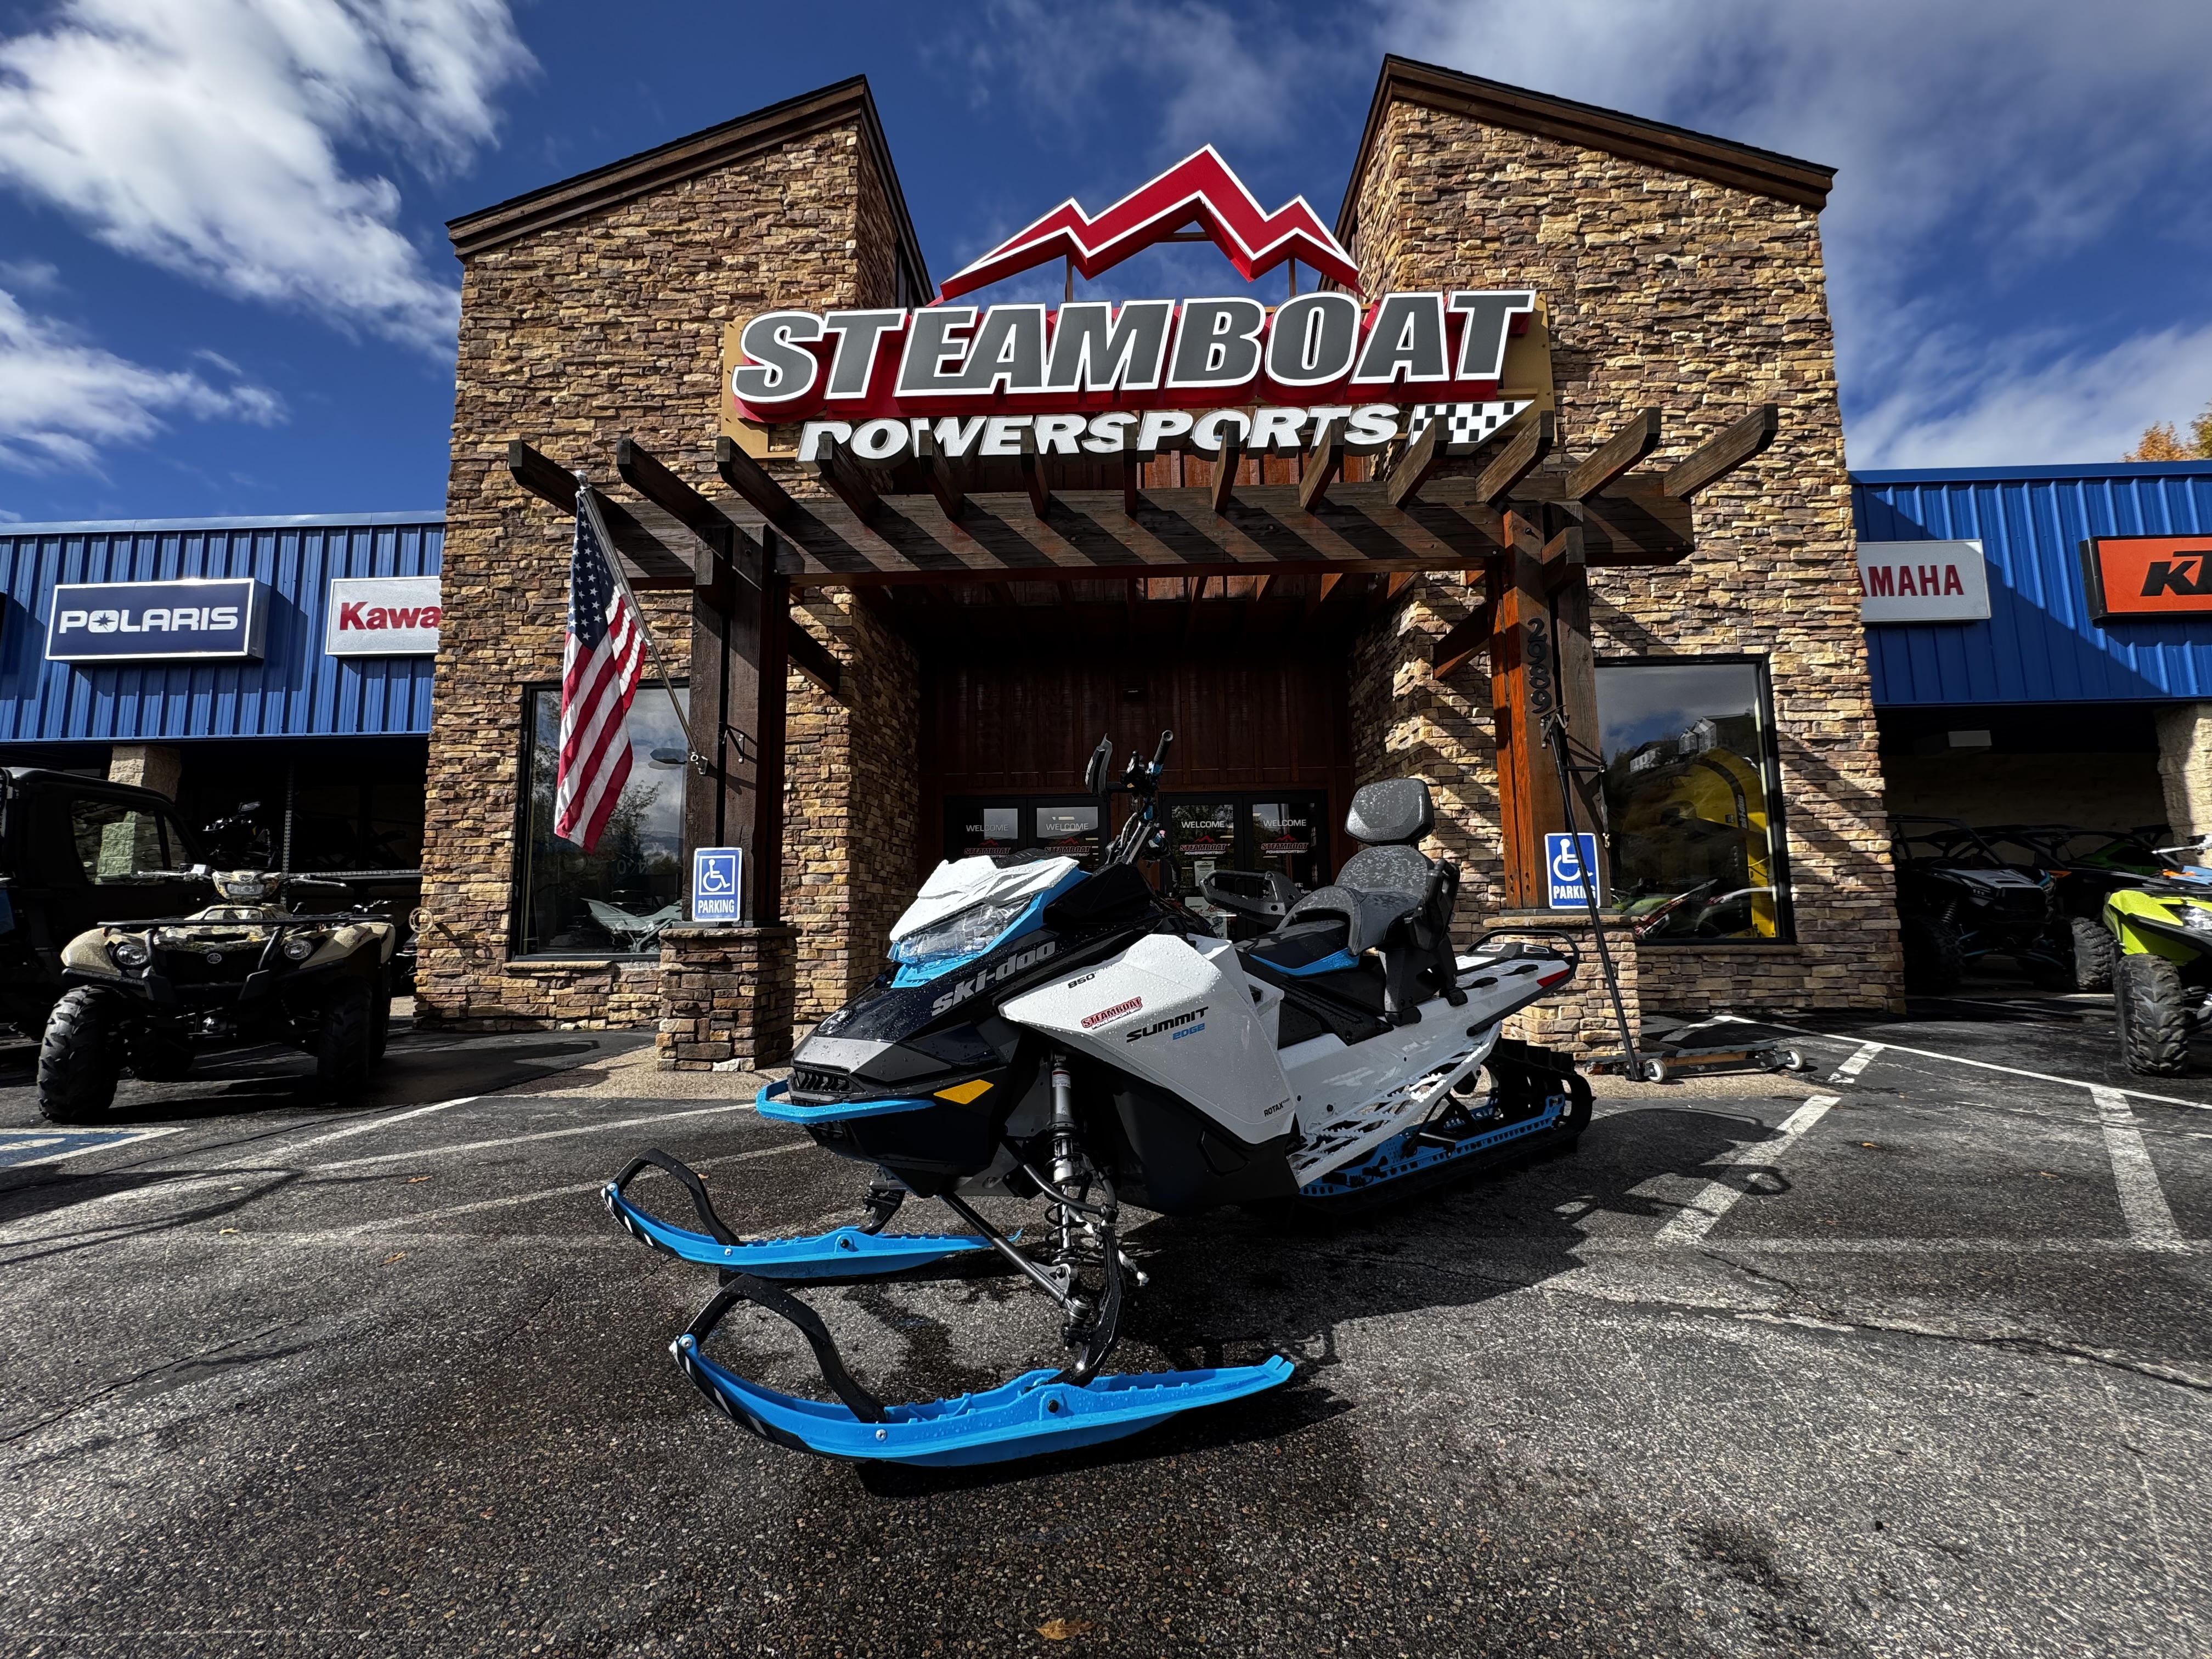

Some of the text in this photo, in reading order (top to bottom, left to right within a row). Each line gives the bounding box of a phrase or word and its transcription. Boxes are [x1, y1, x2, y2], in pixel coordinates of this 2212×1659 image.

[731, 289, 1536, 404] STEAMBOAT
[795, 403, 1400, 461] POWERSPORTS
[59, 607, 238, 634] POLARIS
[1527, 618, 1552, 713] 2989
[1180, 843, 1227, 851] STEAMBOAT
[1261, 842, 1310, 850] STEAMBOAT
[698, 899, 735, 913] PARKING
[932, 941, 1056, 1016] ski-doo
[1081, 997, 1142, 1028] STEAMBOAT
[1126, 1006, 1209, 1043] SUMMIT
[1172, 1023, 1205, 1040] EDGE
[1264, 1102, 1284, 1117] ROTAX
